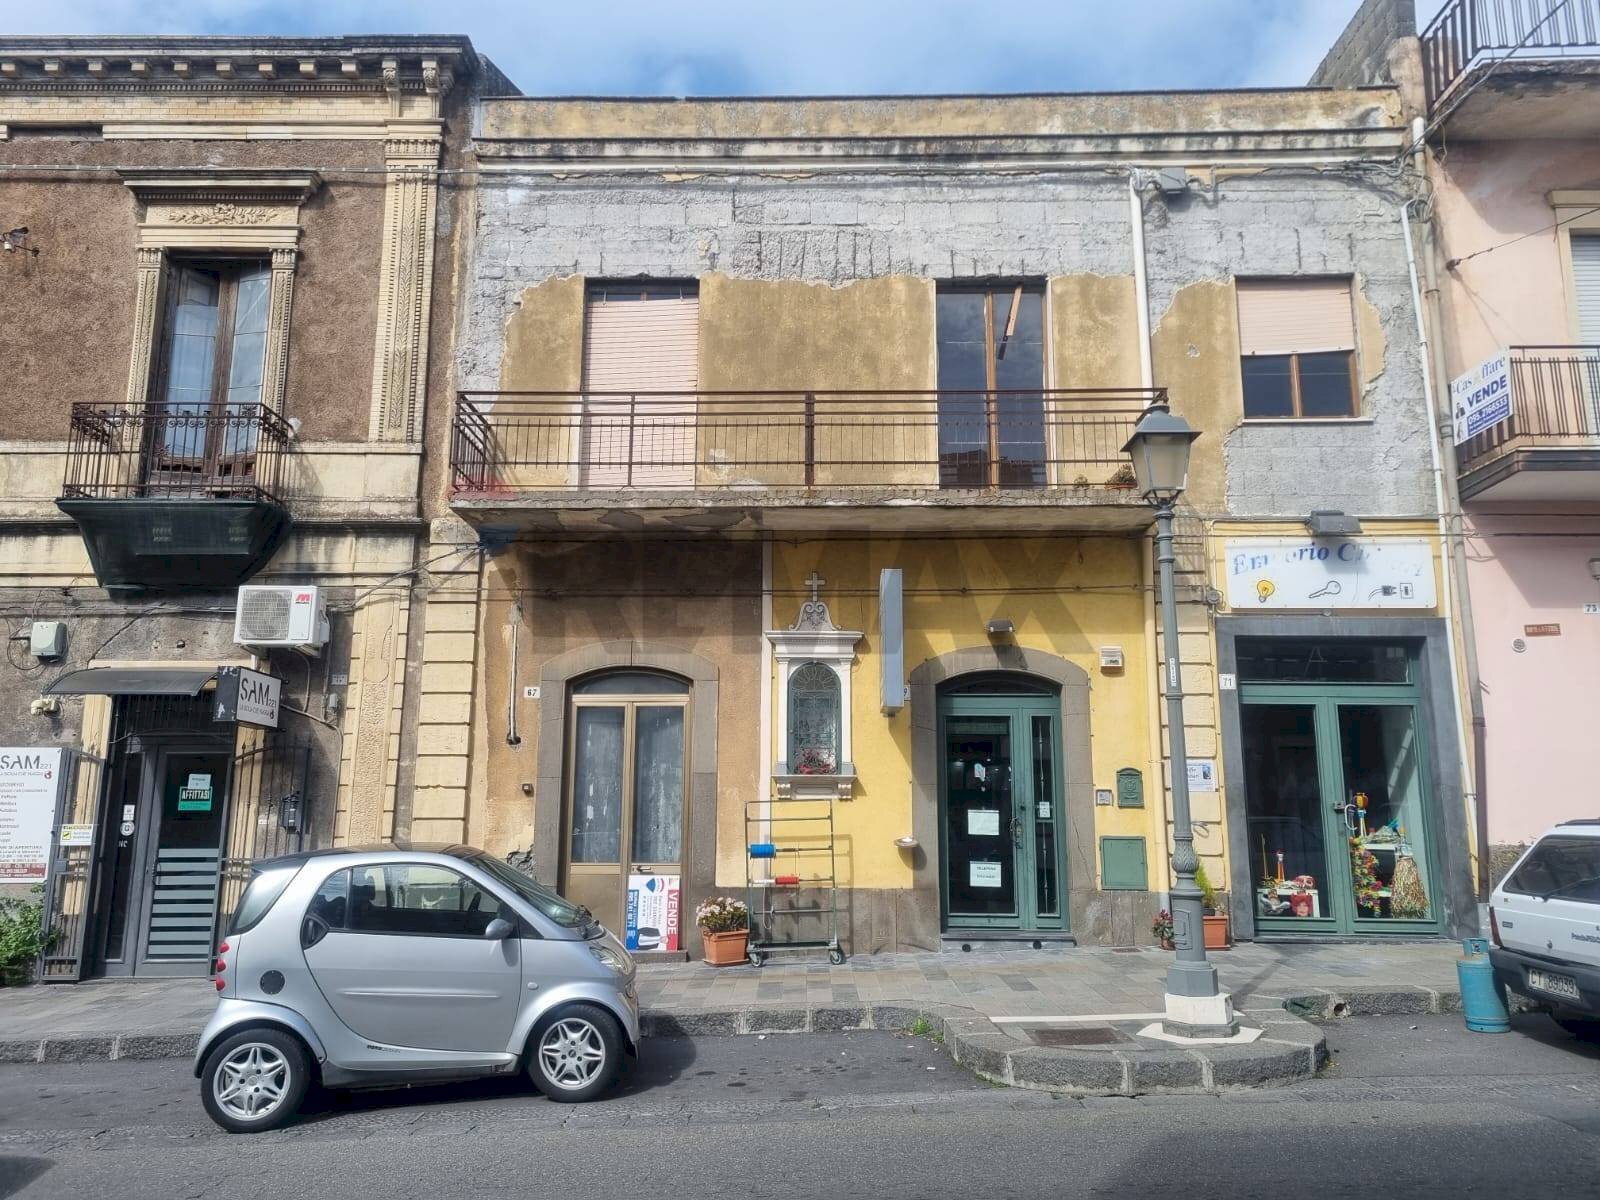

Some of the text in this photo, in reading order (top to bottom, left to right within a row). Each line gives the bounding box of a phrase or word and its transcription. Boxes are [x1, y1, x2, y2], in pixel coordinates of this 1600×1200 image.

[1467, 374, 1507, 408] VENDE
[1223, 677, 1232, 686] 71
[527, 688, 537, 697] 67
[181, 790, 210, 800] AFFITTASI
[667, 891, 679, 935] VENDE
